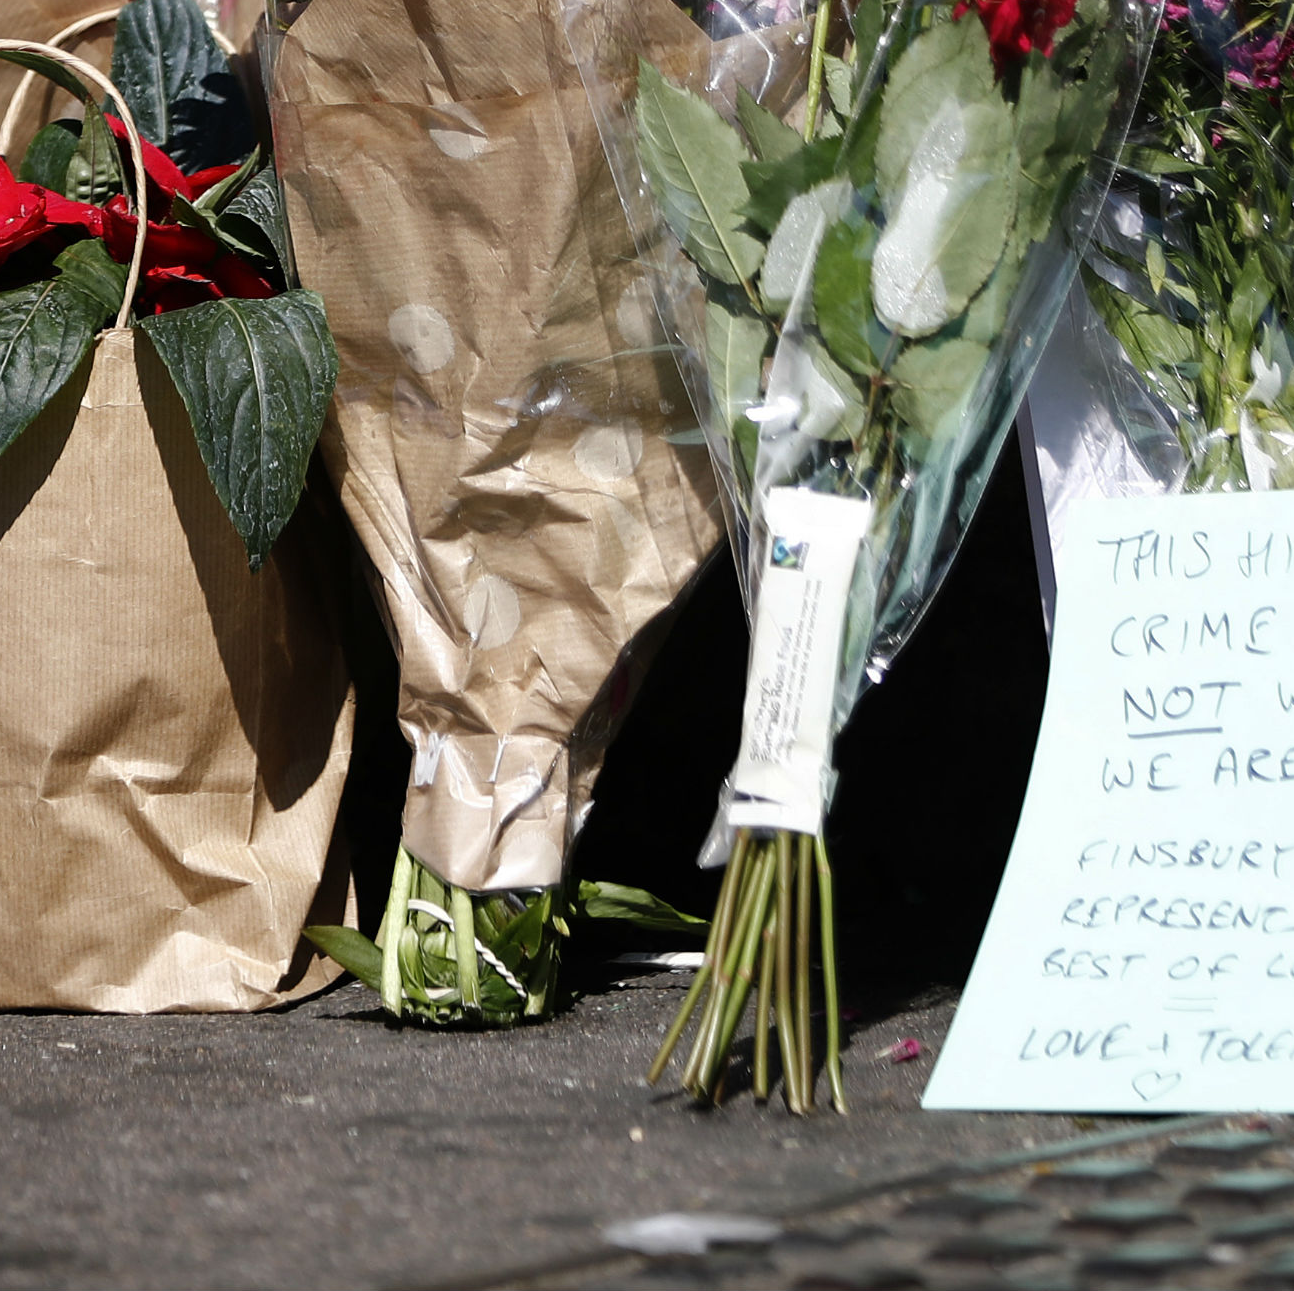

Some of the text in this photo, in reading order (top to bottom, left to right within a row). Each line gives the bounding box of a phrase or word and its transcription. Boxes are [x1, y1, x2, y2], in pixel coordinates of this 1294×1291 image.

[1096, 528, 1212, 583] THIS
[1110, 605, 1278, 658] CRIME
[1122, 680, 1243, 725] NOT
[1101, 751, 1181, 795] WE
[1041, 949, 1147, 981] BEST
[1166, 952, 1239, 982] OF
[1017, 1021, 1138, 1063] LOVE
